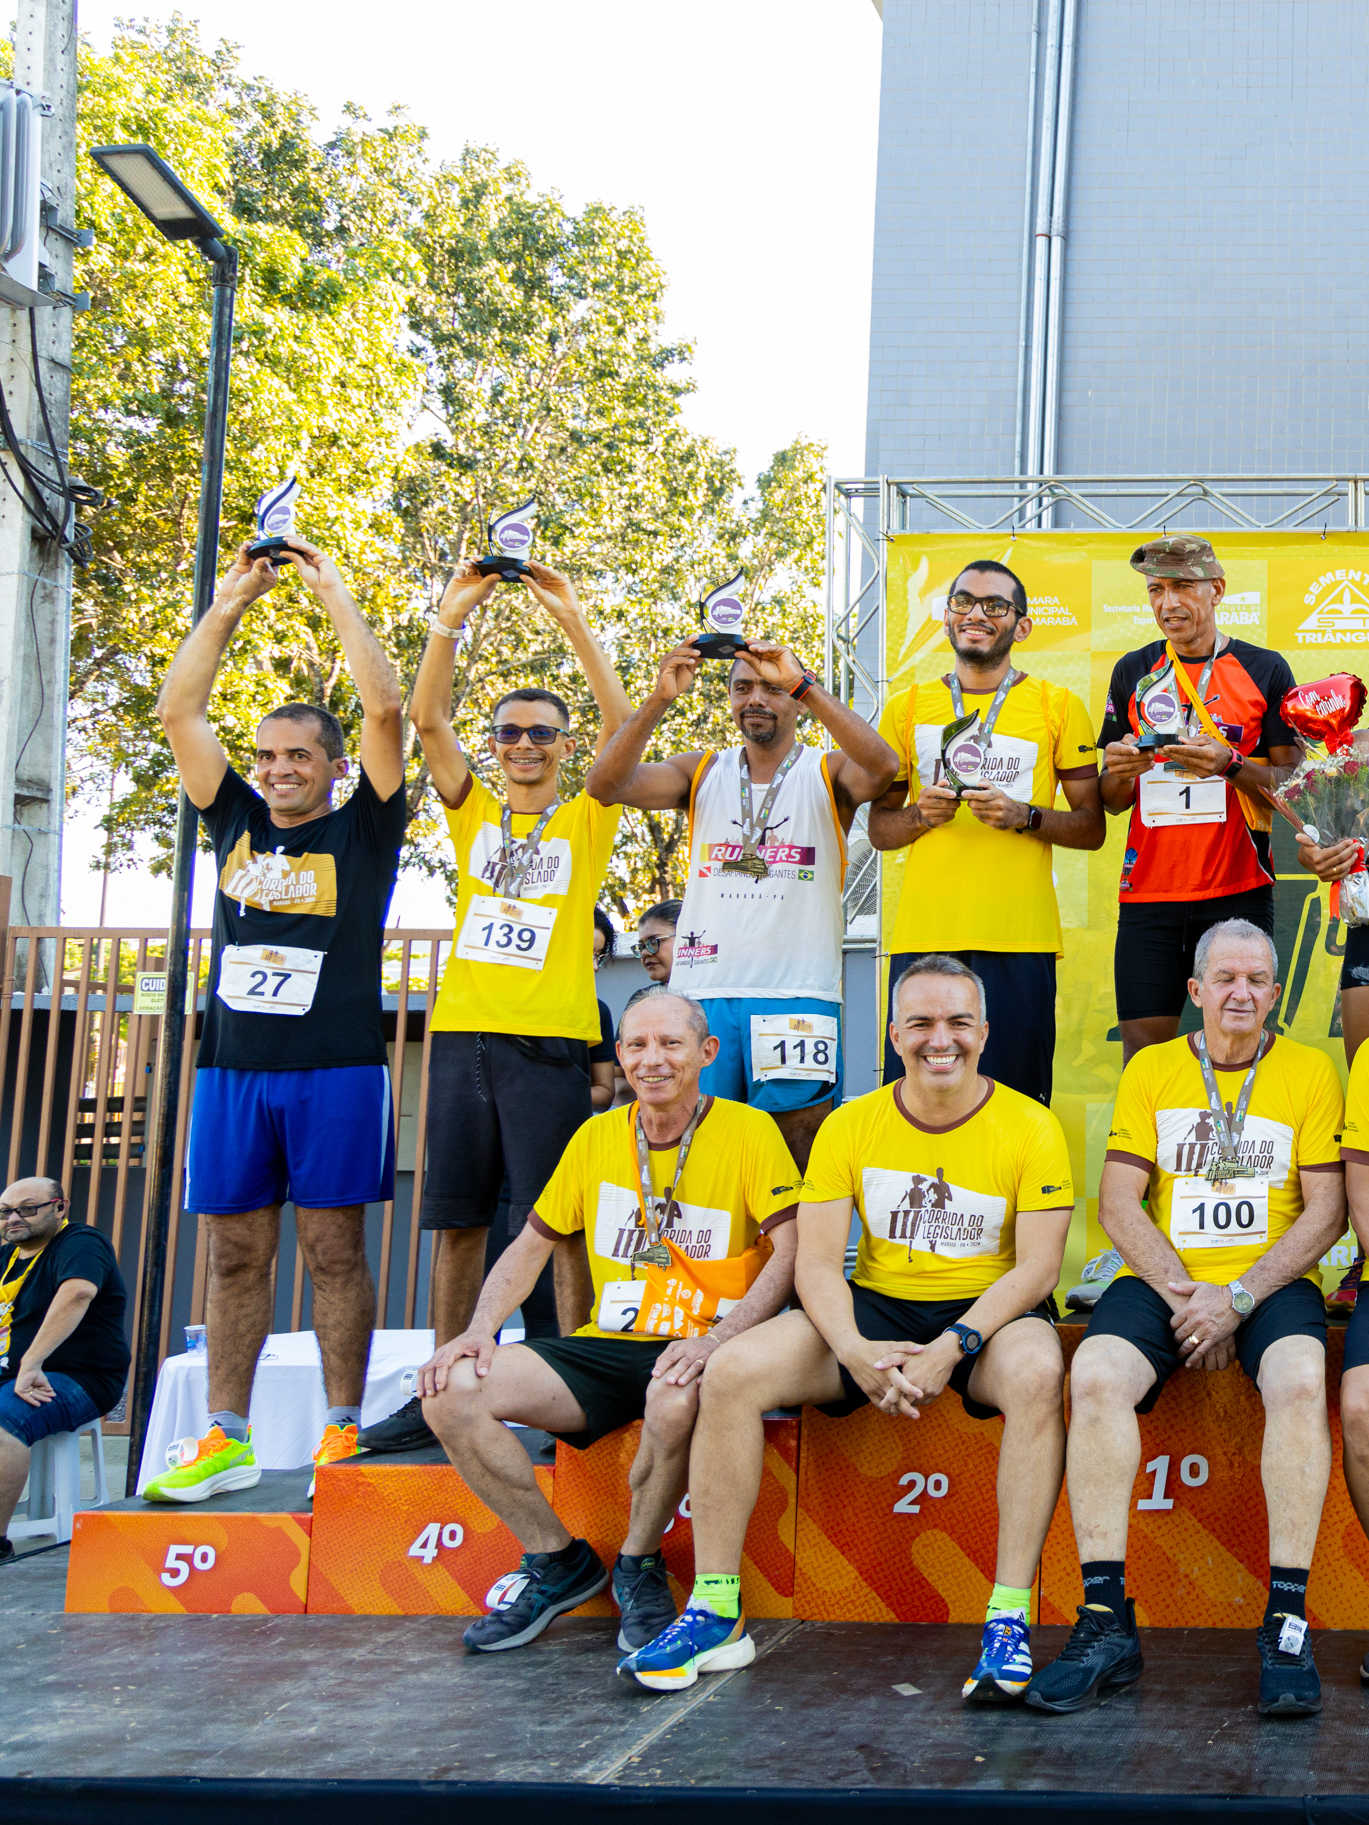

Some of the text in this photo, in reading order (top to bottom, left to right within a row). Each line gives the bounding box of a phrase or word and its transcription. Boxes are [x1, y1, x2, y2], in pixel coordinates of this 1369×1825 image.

[1026, 596, 1060, 605] MARA
[1102, 604, 1140, 613] Secretaria
[1007, 757, 1020, 770] DO
[1179, 786, 1191, 809] 1
[547, 856, 560, 869] DO
[300, 870, 314, 884] DO
[482, 922, 536, 952] 139
[246, 970, 292, 997] 27
[772, 1039, 829, 1065] 118
[1260, 1140, 1274, 1154] DO
[922, 1208, 984, 1228] CORRIDA DO
[1191, 1201, 1255, 1230] 100
[696, 1229, 712, 1244] DO
[922, 1225, 984, 1241] LEGISLADOR
